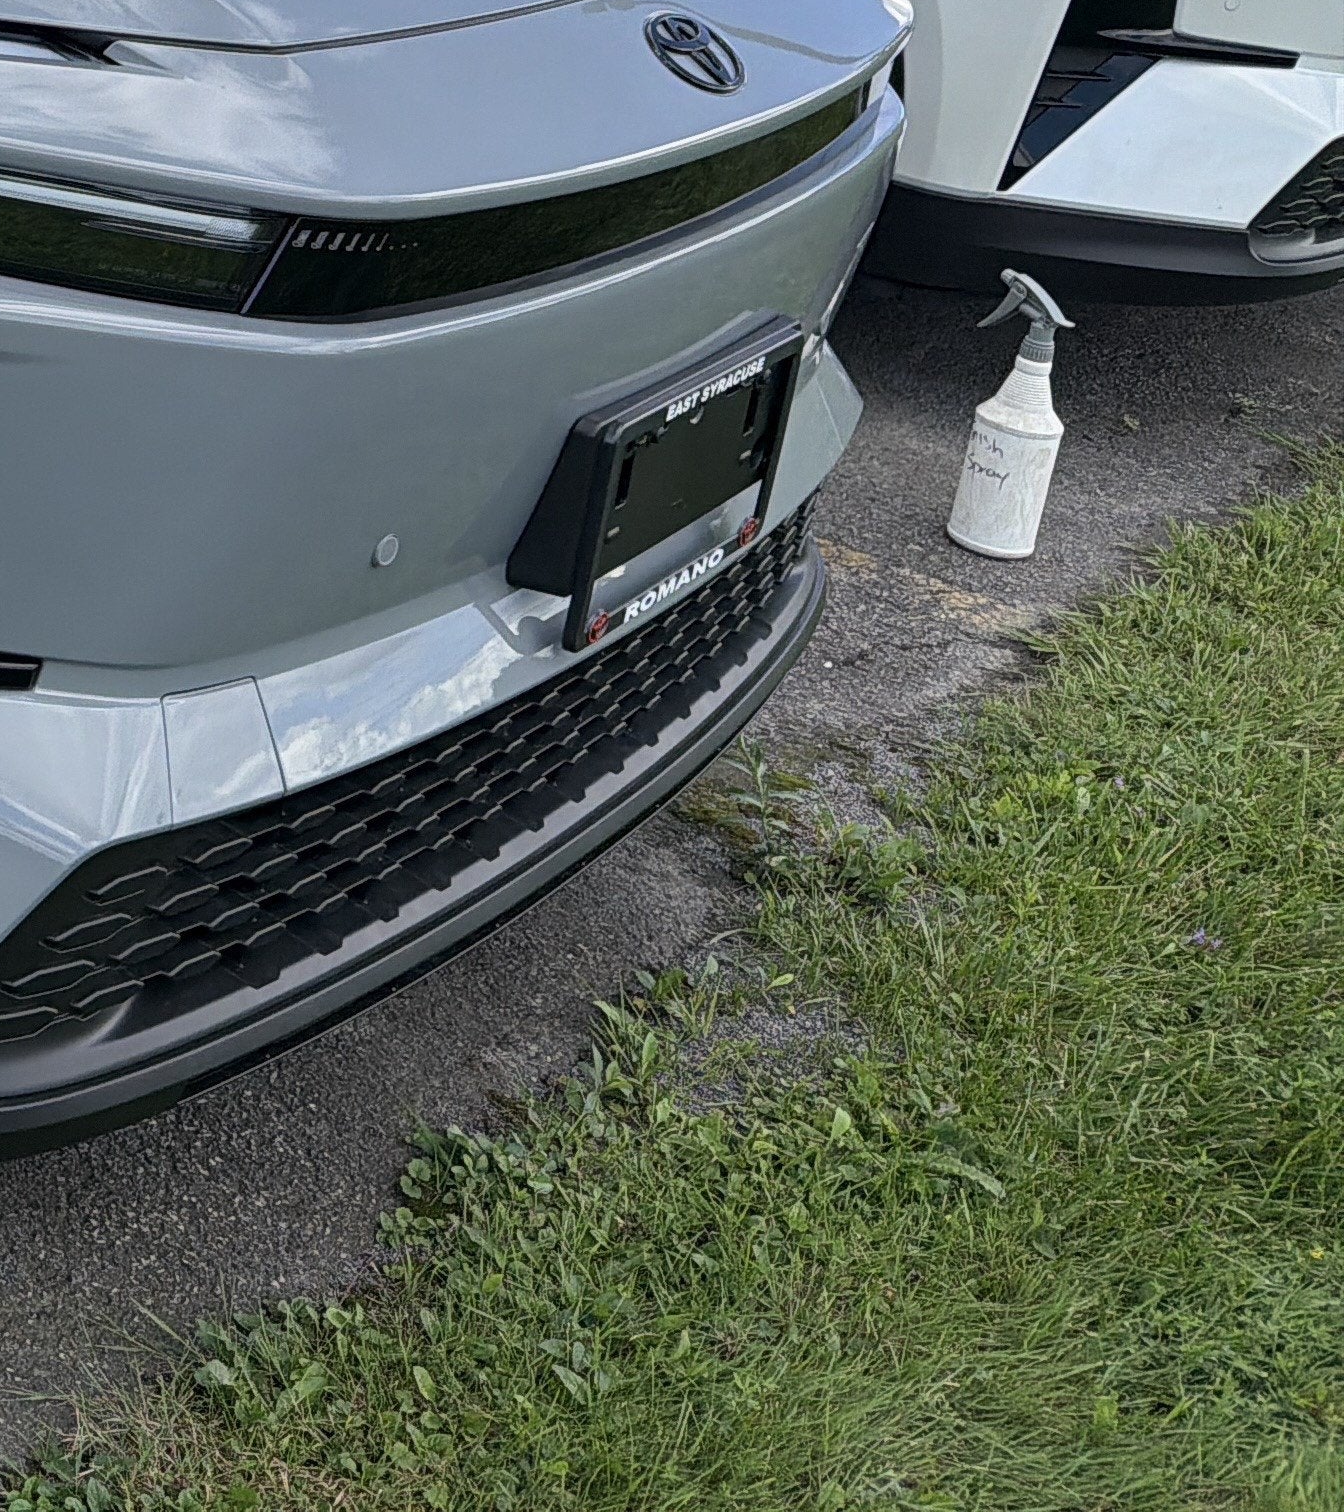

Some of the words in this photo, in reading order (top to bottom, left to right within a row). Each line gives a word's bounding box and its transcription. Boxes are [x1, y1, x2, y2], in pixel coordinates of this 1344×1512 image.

[665, 391, 700, 422] EAST
[701, 356, 766, 403] SYRACUSE
[623, 548, 725, 625] ROMANO
